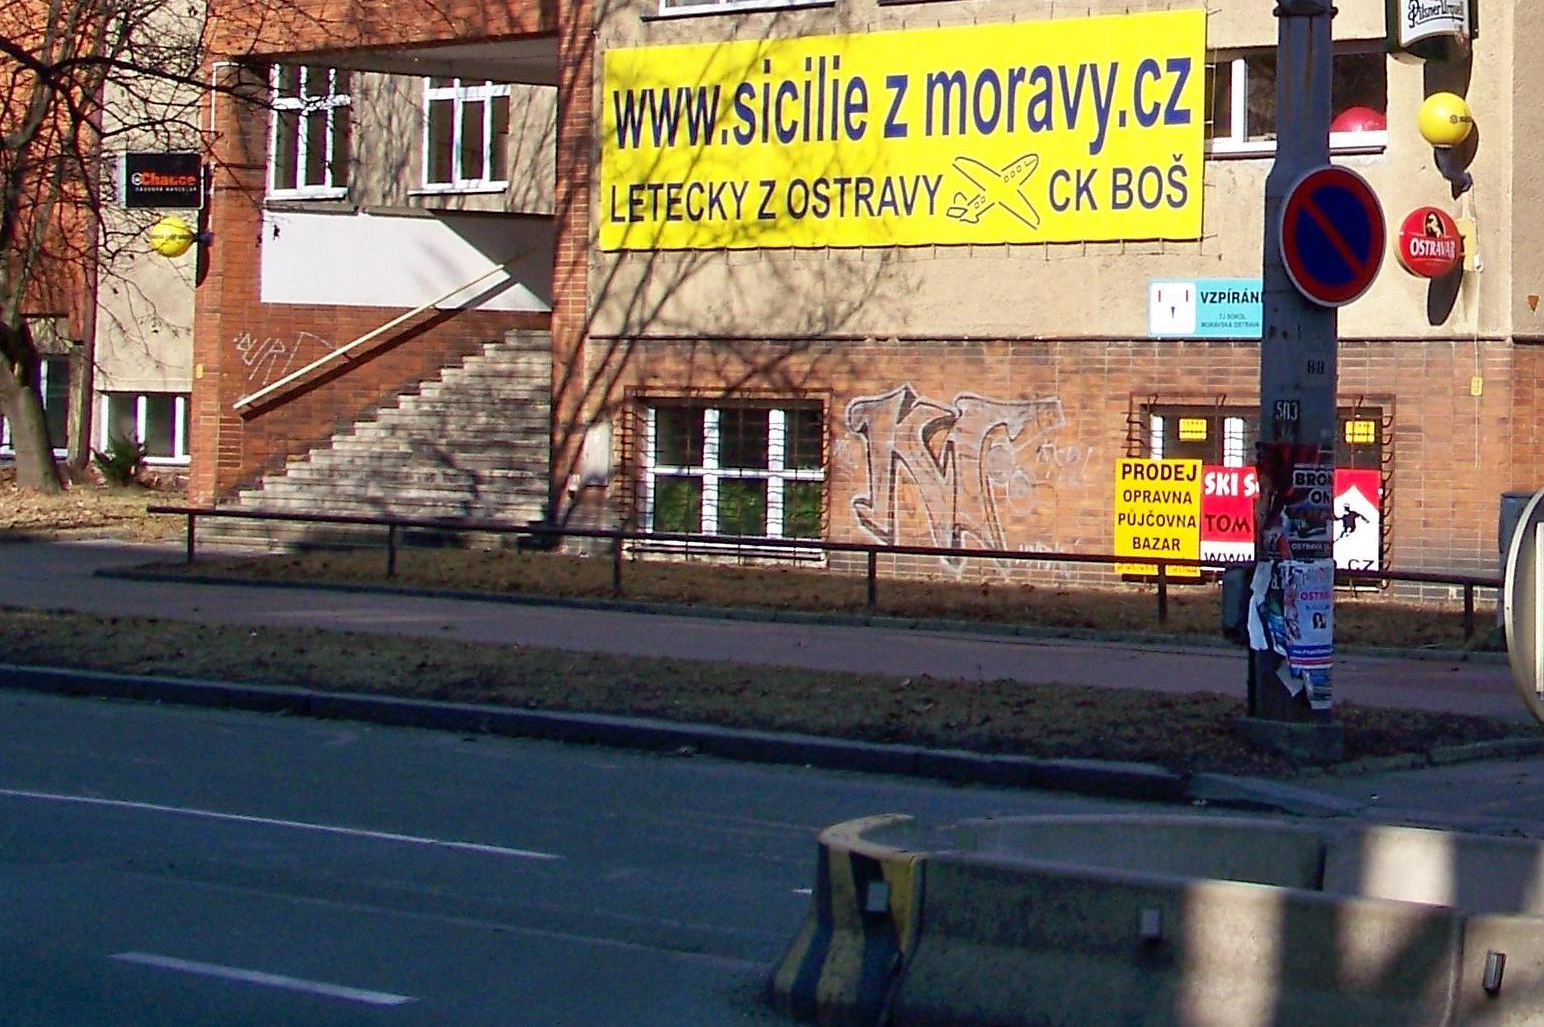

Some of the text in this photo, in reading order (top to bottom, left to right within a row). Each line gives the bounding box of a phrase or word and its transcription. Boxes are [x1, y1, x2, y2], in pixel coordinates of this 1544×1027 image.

[613, 54, 1192, 156] www.sicilie z moravy.cz
[610, 152, 1189, 223] LETECKY Z OSTRAVY CK BOŠ
[1409, 237, 1456, 260] OSTRAVAR
[1121, 463, 1197, 482] PRODEJ
[1203, 472, 1239, 497] SKI
[1123, 489, 1193, 505] OPRAVNA
[1117, 508, 1197, 528] PŮJČOVNA
[1132, 536, 1181, 552] BAZAR
